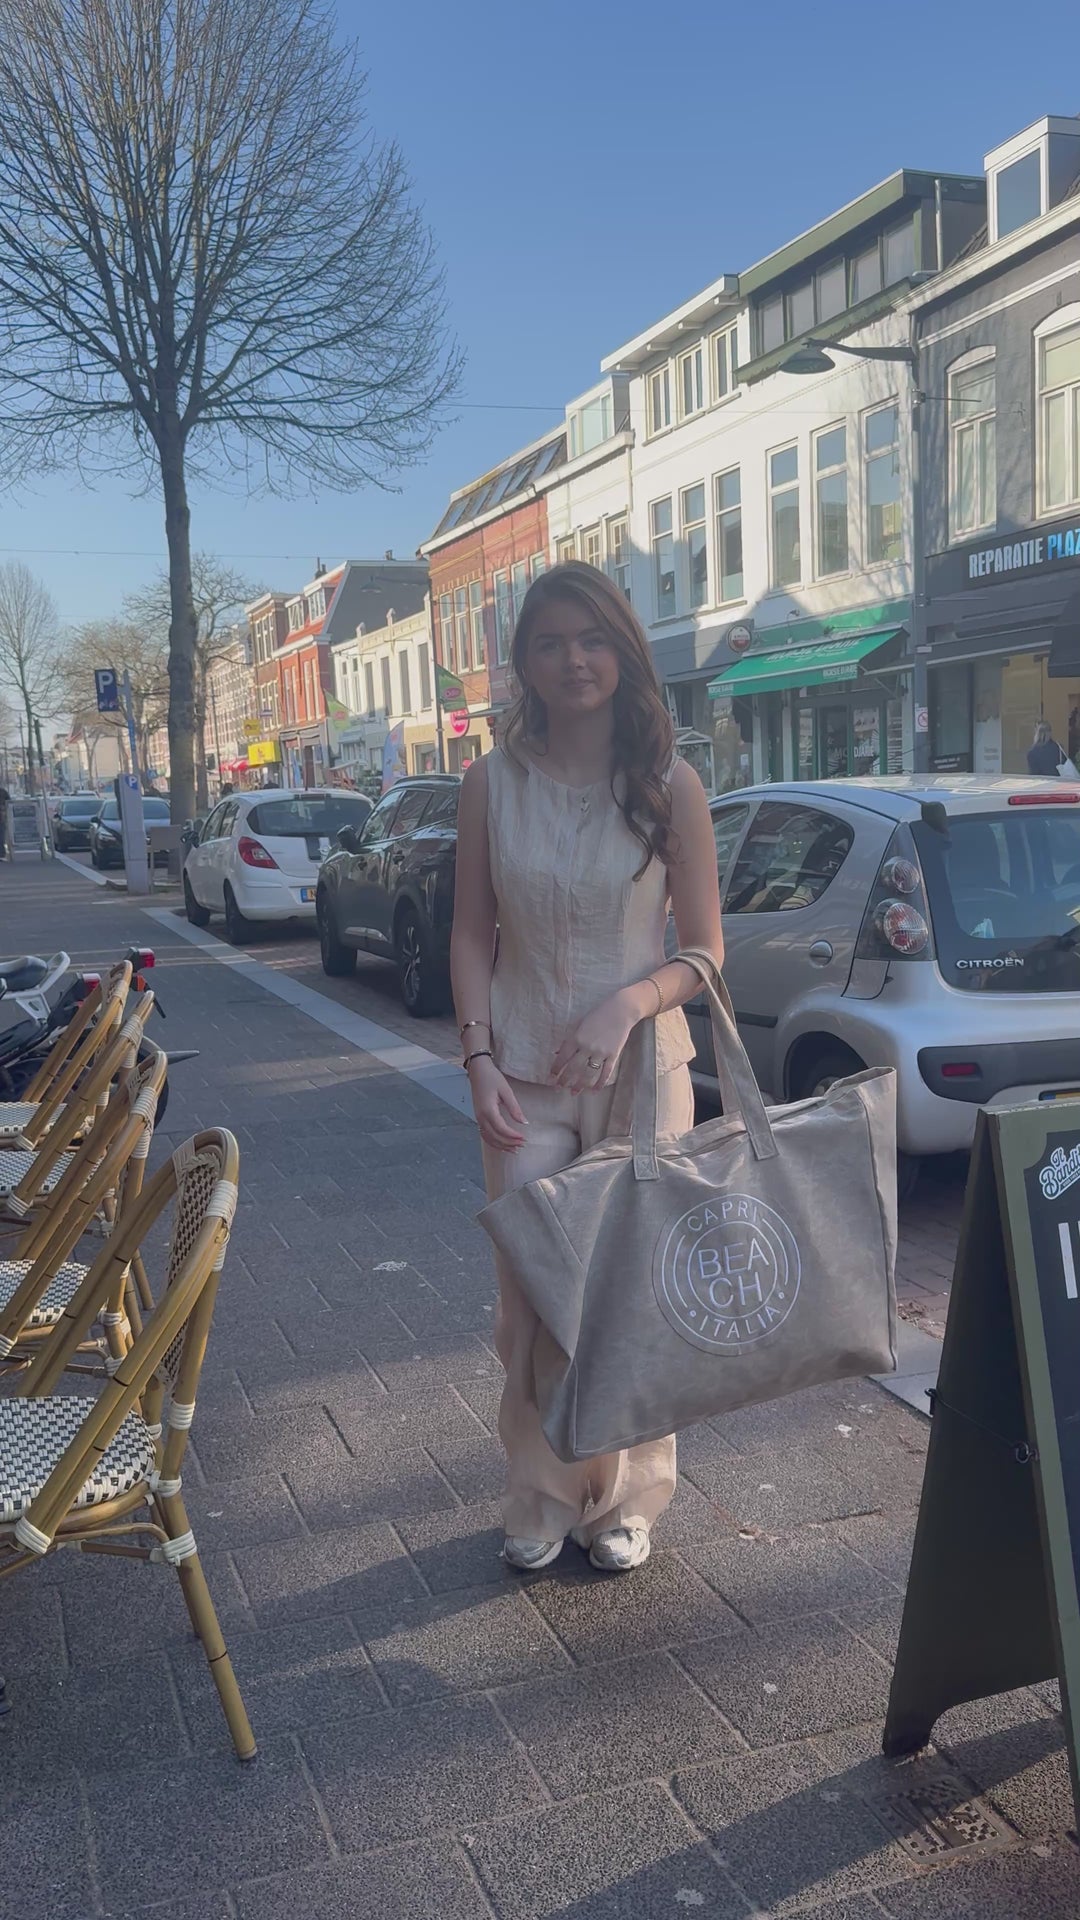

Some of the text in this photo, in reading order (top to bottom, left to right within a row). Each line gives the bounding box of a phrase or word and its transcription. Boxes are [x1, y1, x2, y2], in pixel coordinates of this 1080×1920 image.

[968, 537, 1043, 578] REPARATIE
[98, 671, 113, 693] P
[129, 776, 137, 787] P
[956, 957, 1025, 969] CITROËN
[1040, 1144, 1080, 1198] Bandi
[687, 1201, 757, 1231] CAPRI
[698, 1238, 769, 1279] BEA
[709, 1272, 763, 1308] CH
[700, 1305, 780, 1338] ITALIA
